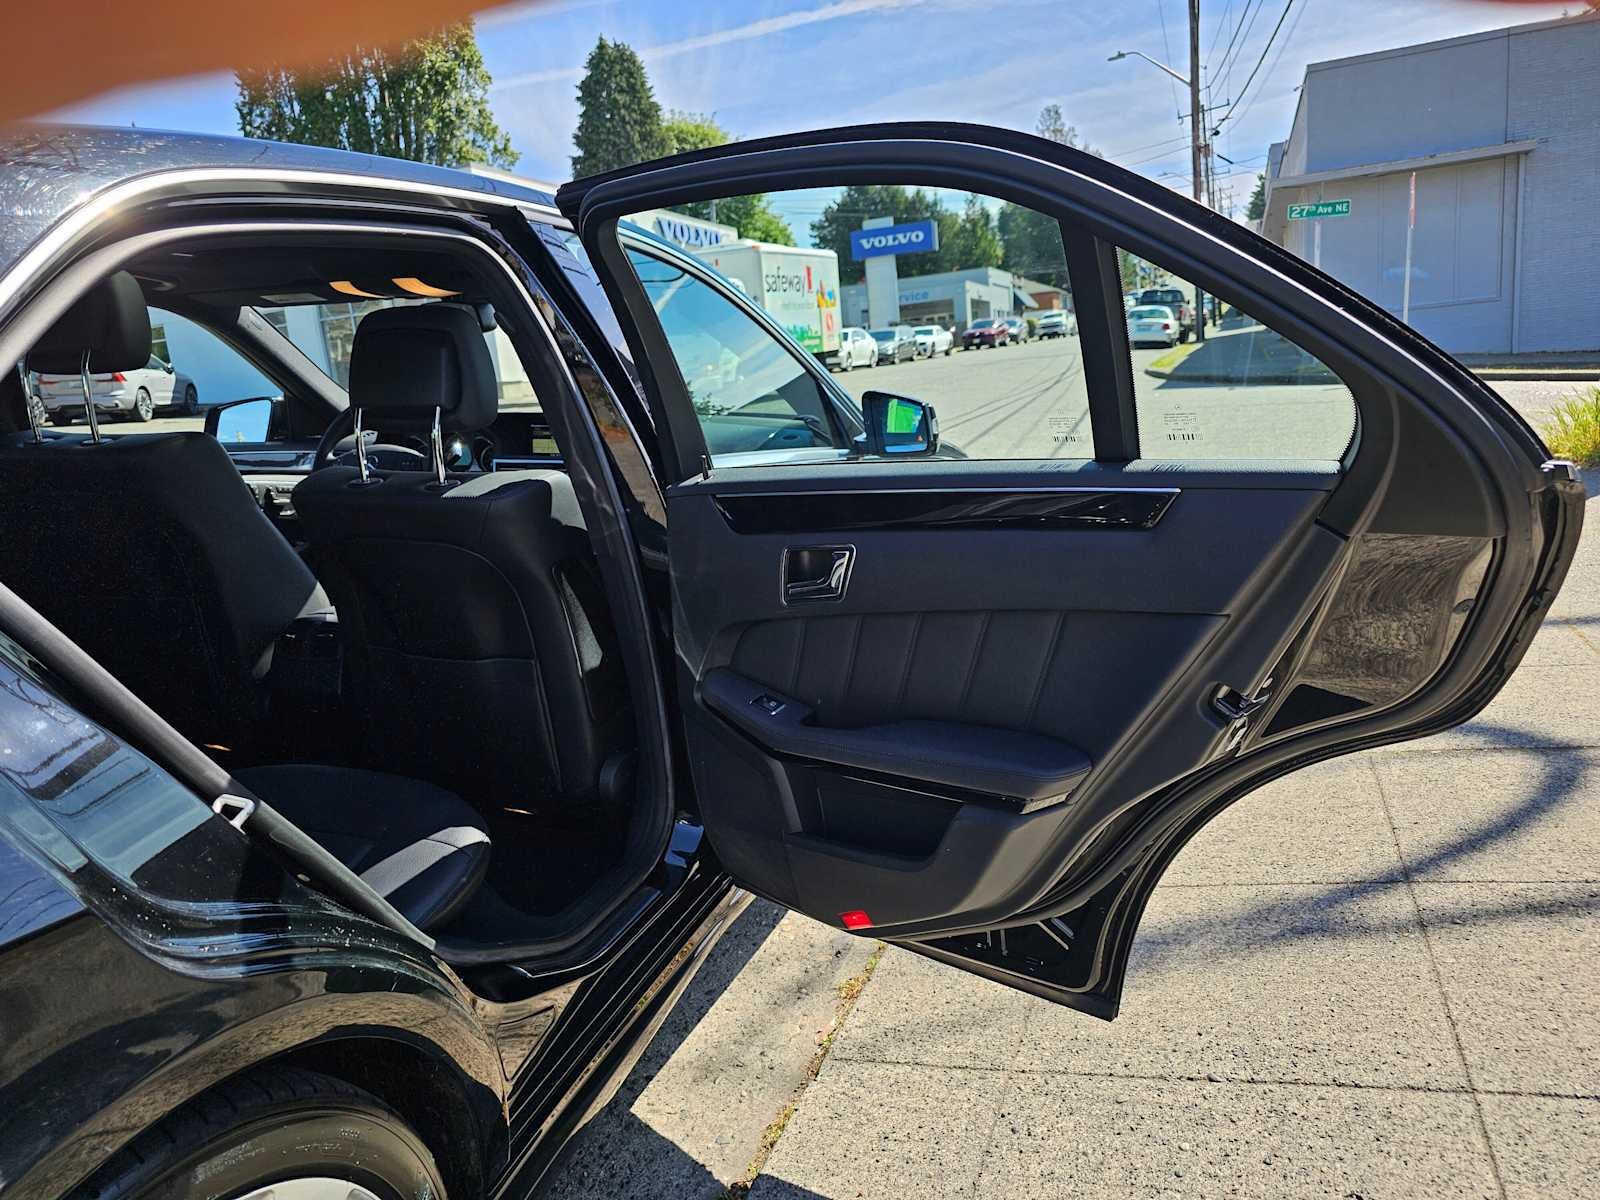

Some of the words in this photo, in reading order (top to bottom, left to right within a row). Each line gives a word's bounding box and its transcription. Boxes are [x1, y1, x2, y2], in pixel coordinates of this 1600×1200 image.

[1317, 205, 1333, 215] Ave
[1335, 202, 1349, 213] NE
[655, 216, 721, 247] VOLVO
[860, 230, 925, 250] VOLVO
[899, 289, 929, 303] rvice
